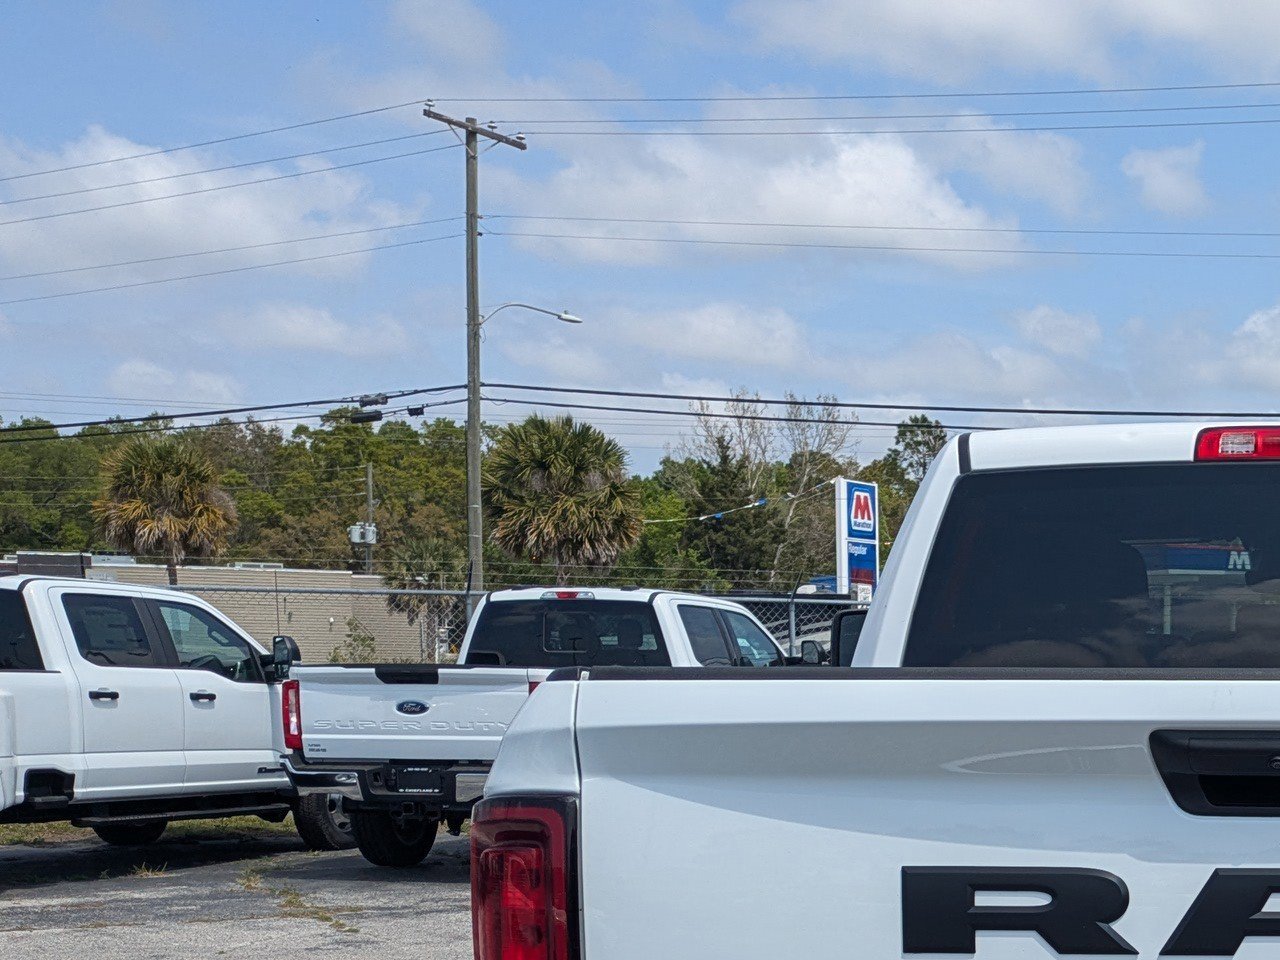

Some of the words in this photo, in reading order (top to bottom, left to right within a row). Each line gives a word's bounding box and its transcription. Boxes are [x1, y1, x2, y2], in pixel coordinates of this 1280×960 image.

[853, 494, 872, 521] M
[848, 543, 868, 556] Regular
[1228, 551, 1251, 569] M
[313, 720, 422, 731] SUPER
